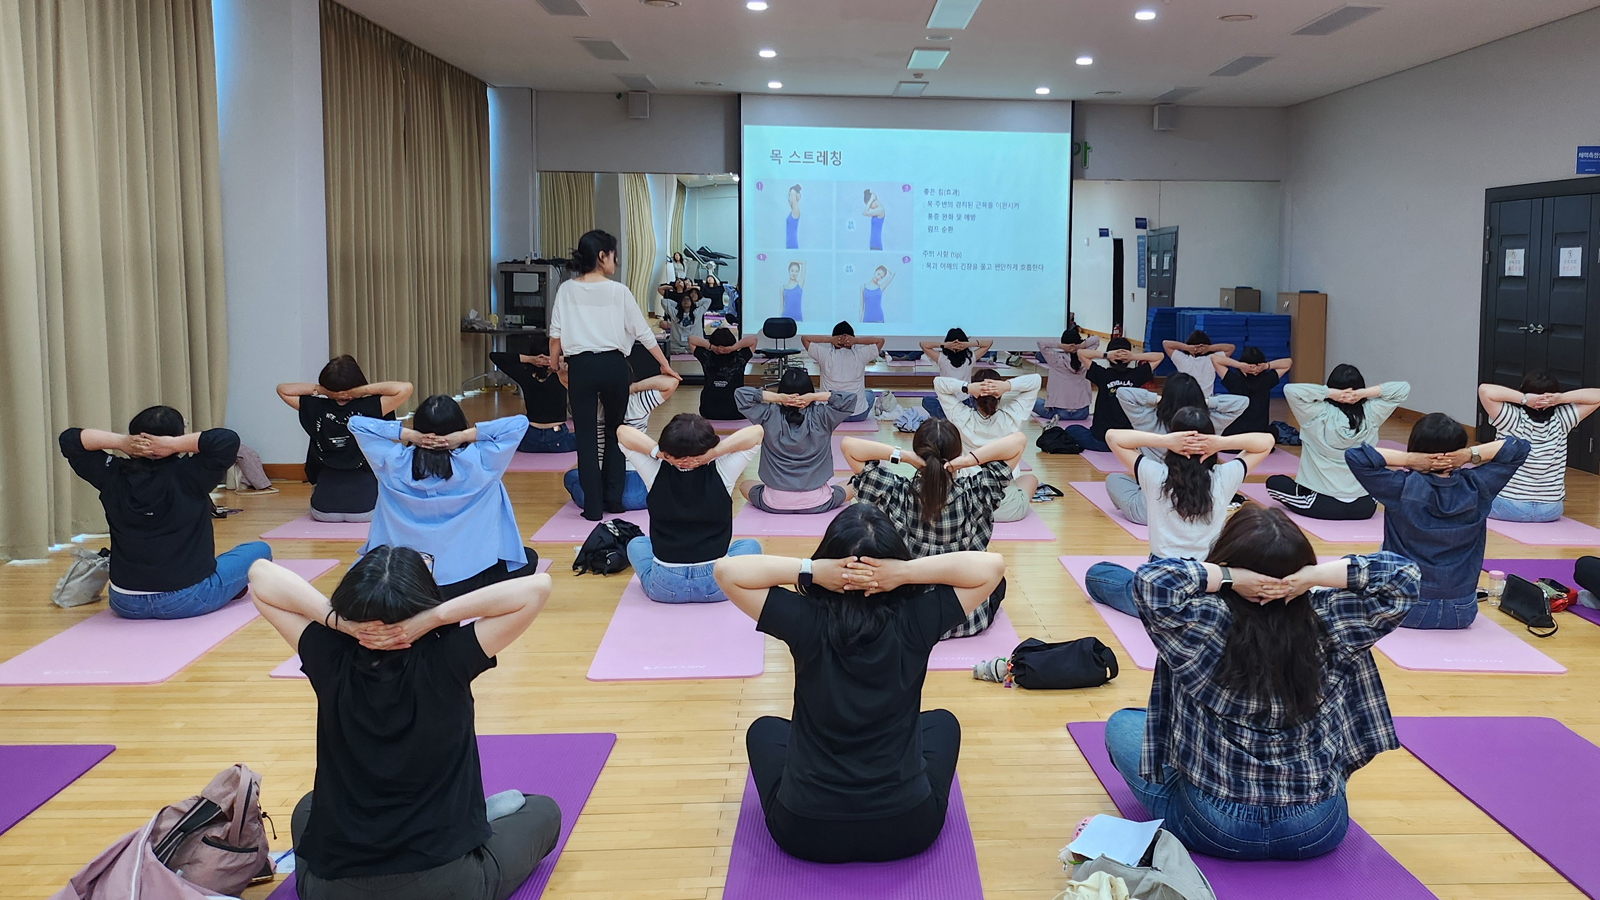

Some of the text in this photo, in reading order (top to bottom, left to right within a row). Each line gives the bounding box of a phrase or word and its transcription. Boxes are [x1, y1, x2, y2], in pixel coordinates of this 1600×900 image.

[770, 149, 842, 167] 목 스트레칭
[924, 188, 935, 196] 좋은
[927, 213, 939, 221] 통증
[964, 214, 976, 222] 예방
[941, 226, 954, 234] 순환
[922, 250, 962, 259] 주의 사항 (tip)
[995, 263, 1018, 271] 편안하게
